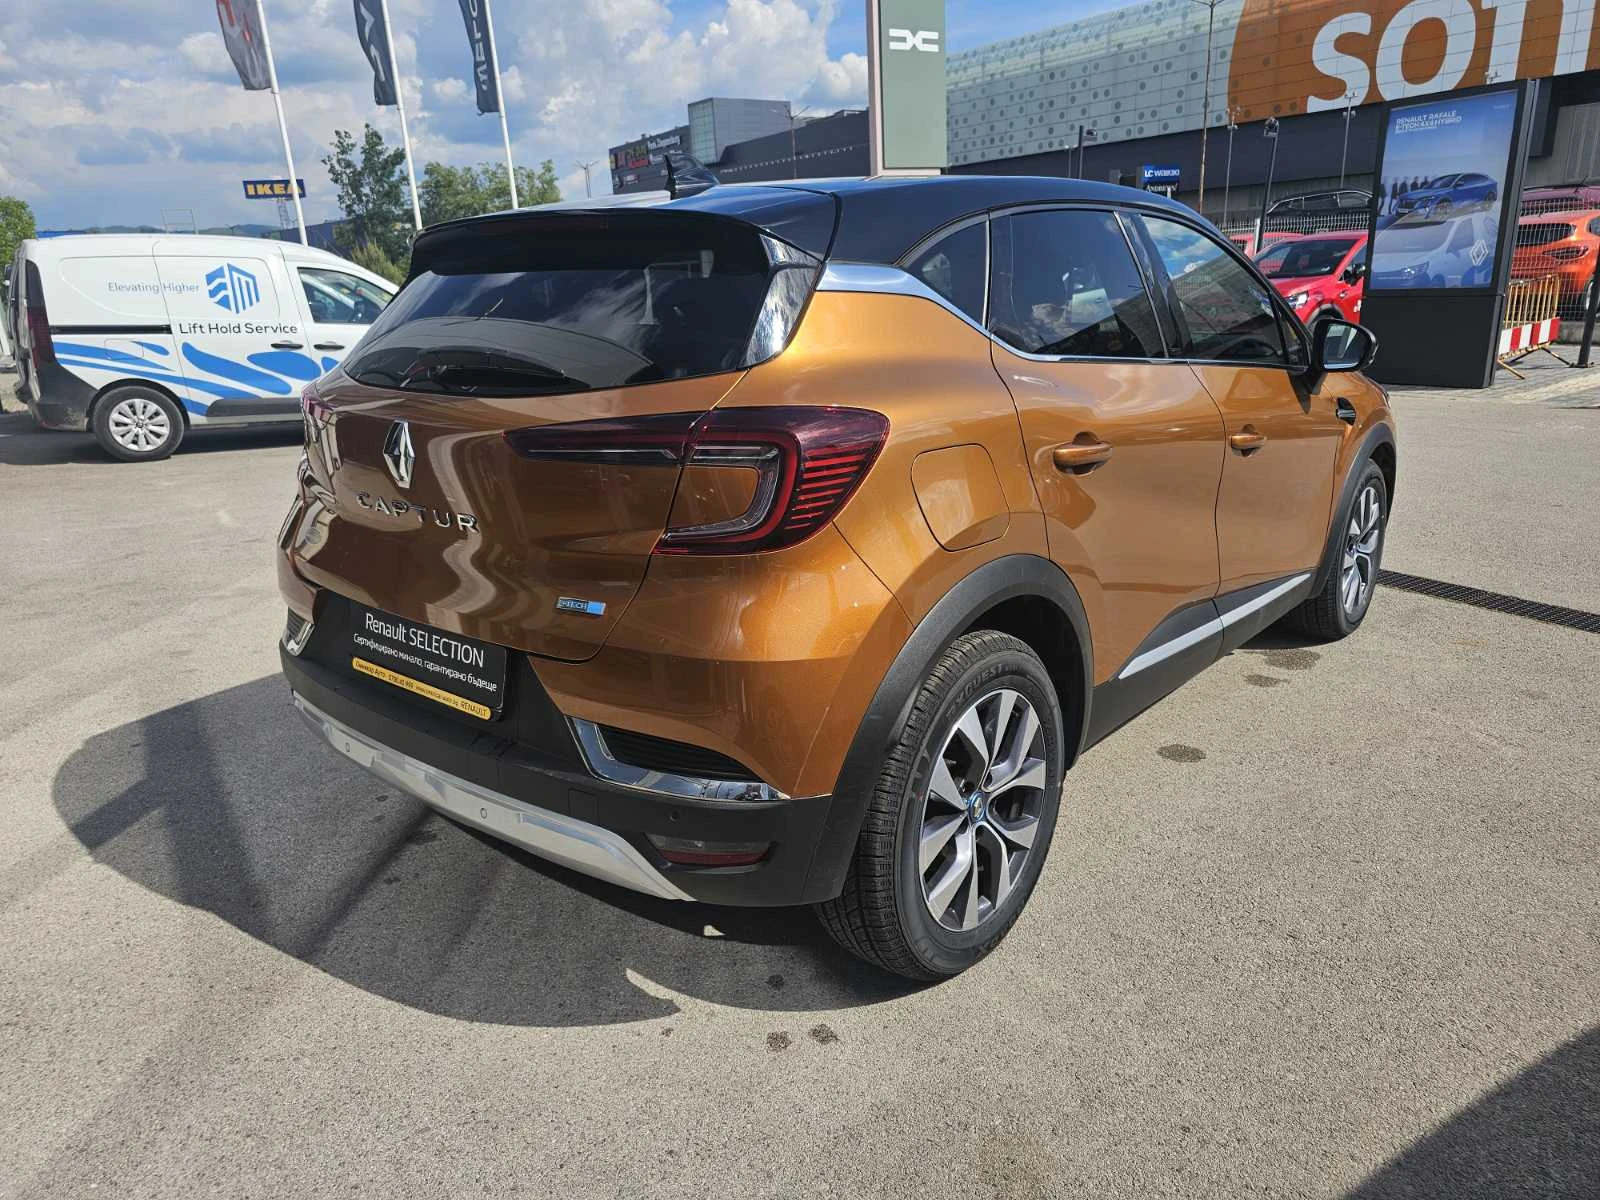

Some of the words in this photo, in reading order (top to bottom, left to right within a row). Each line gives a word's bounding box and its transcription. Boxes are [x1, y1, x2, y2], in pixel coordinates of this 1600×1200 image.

[246, 183, 302, 196] IKEA
[107, 281, 160, 294] Elevating
[163, 282, 200, 294] Higher
[179, 323, 204, 334] Lift
[208, 323, 241, 334] Hold
[245, 323, 298, 334] Service
[356, 490, 480, 534] CAPTUR
[365, 612, 407, 643] Renault
[408, 628, 484, 668] SELECTION
[424, 660, 467, 682] гарантирано
[467, 673, 498, 692] бъдеще
